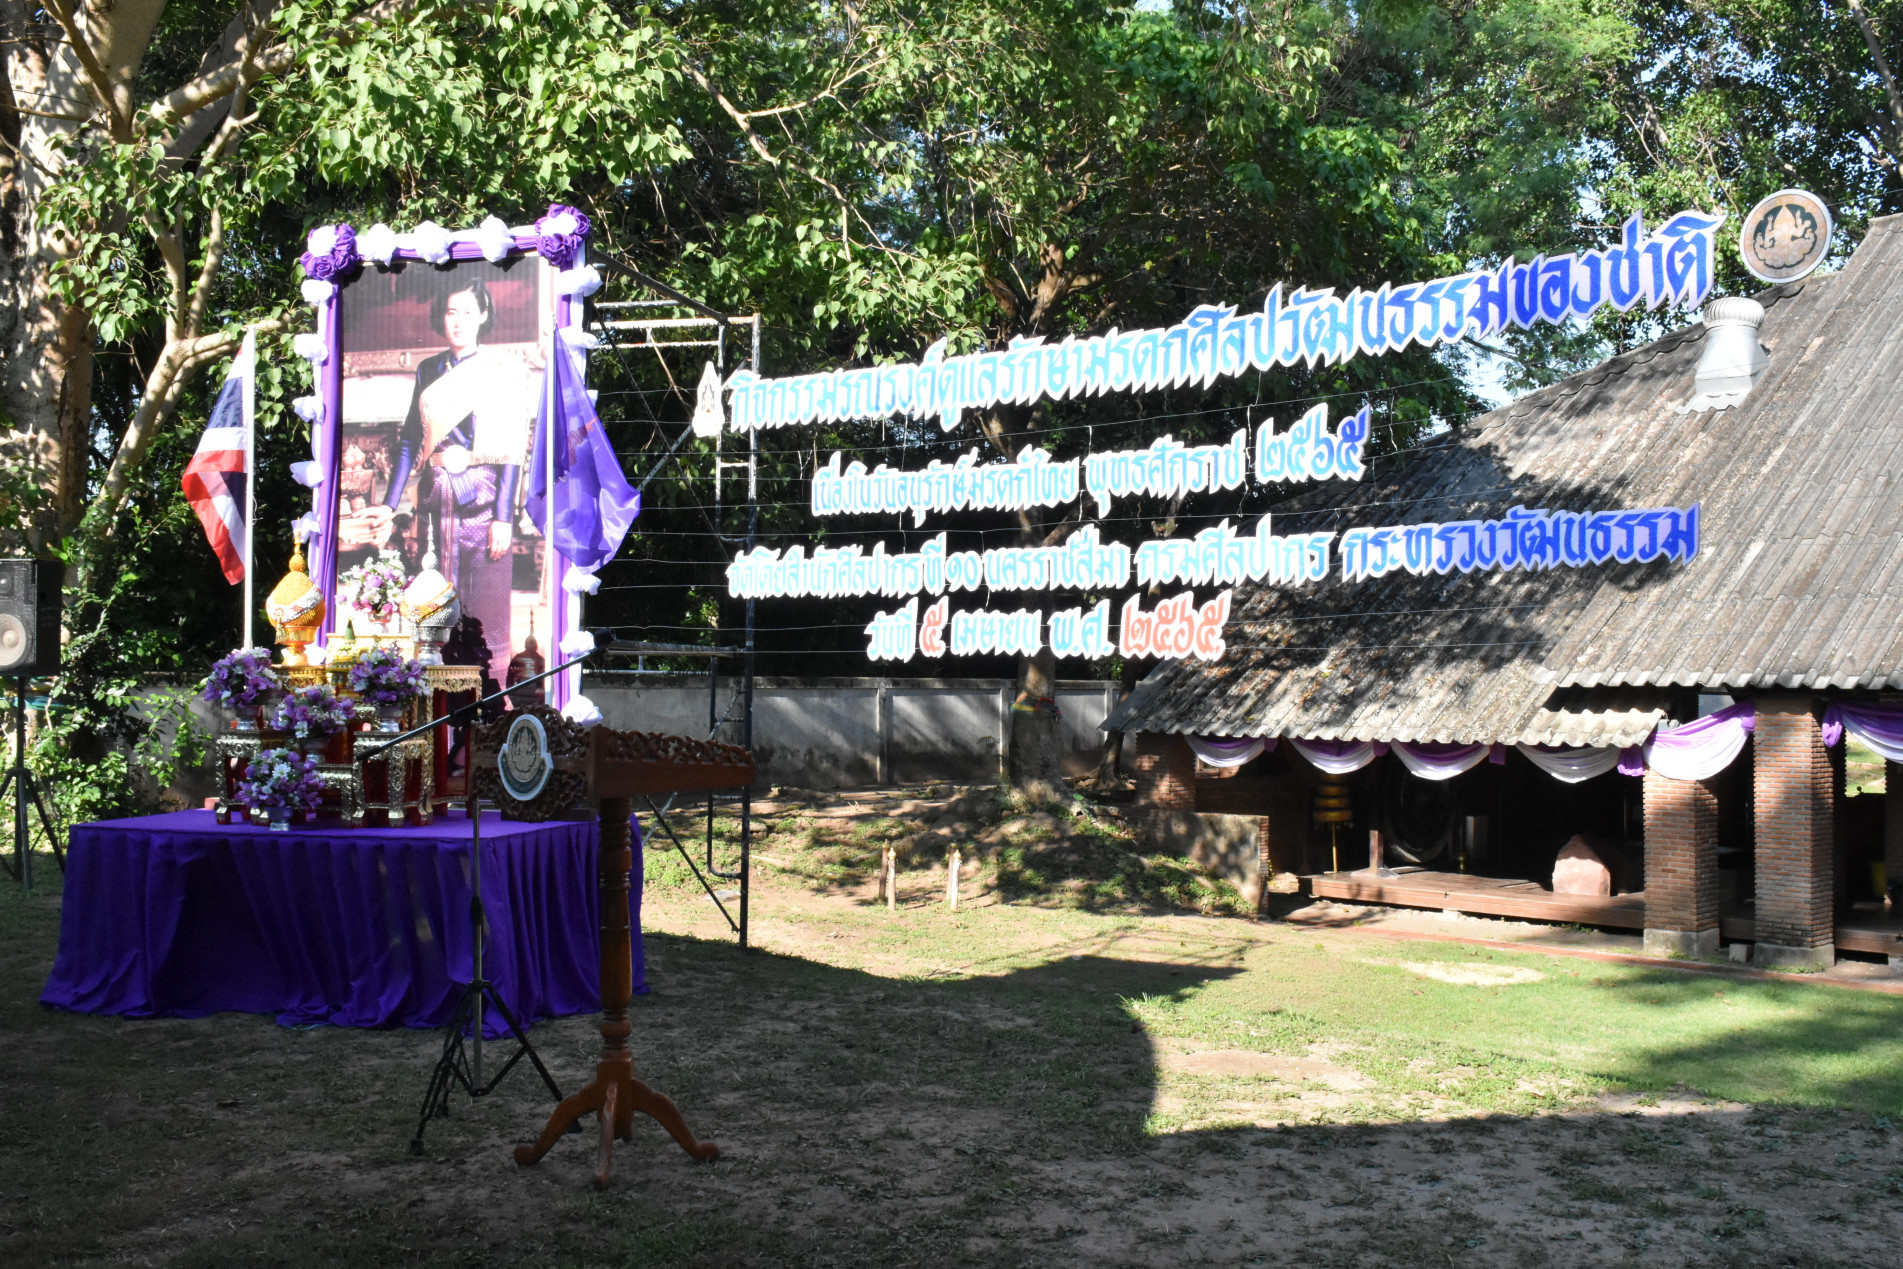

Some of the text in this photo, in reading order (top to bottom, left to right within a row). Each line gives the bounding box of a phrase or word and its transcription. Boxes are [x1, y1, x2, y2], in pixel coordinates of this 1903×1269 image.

[813, 404, 1371, 526] เนื่องในวันอนุรักษ์มรดกไทย พุทธศักราช ๒๕๖๕
[1136, 515, 1333, 586] กรมศิลปากร
[1342, 504, 1698, 582] กระทรวงวัฒนธรรม
[866, 589, 1232, 662] วันที่ ๕ เมษายน พ.ศ. ๒๕๖๕
